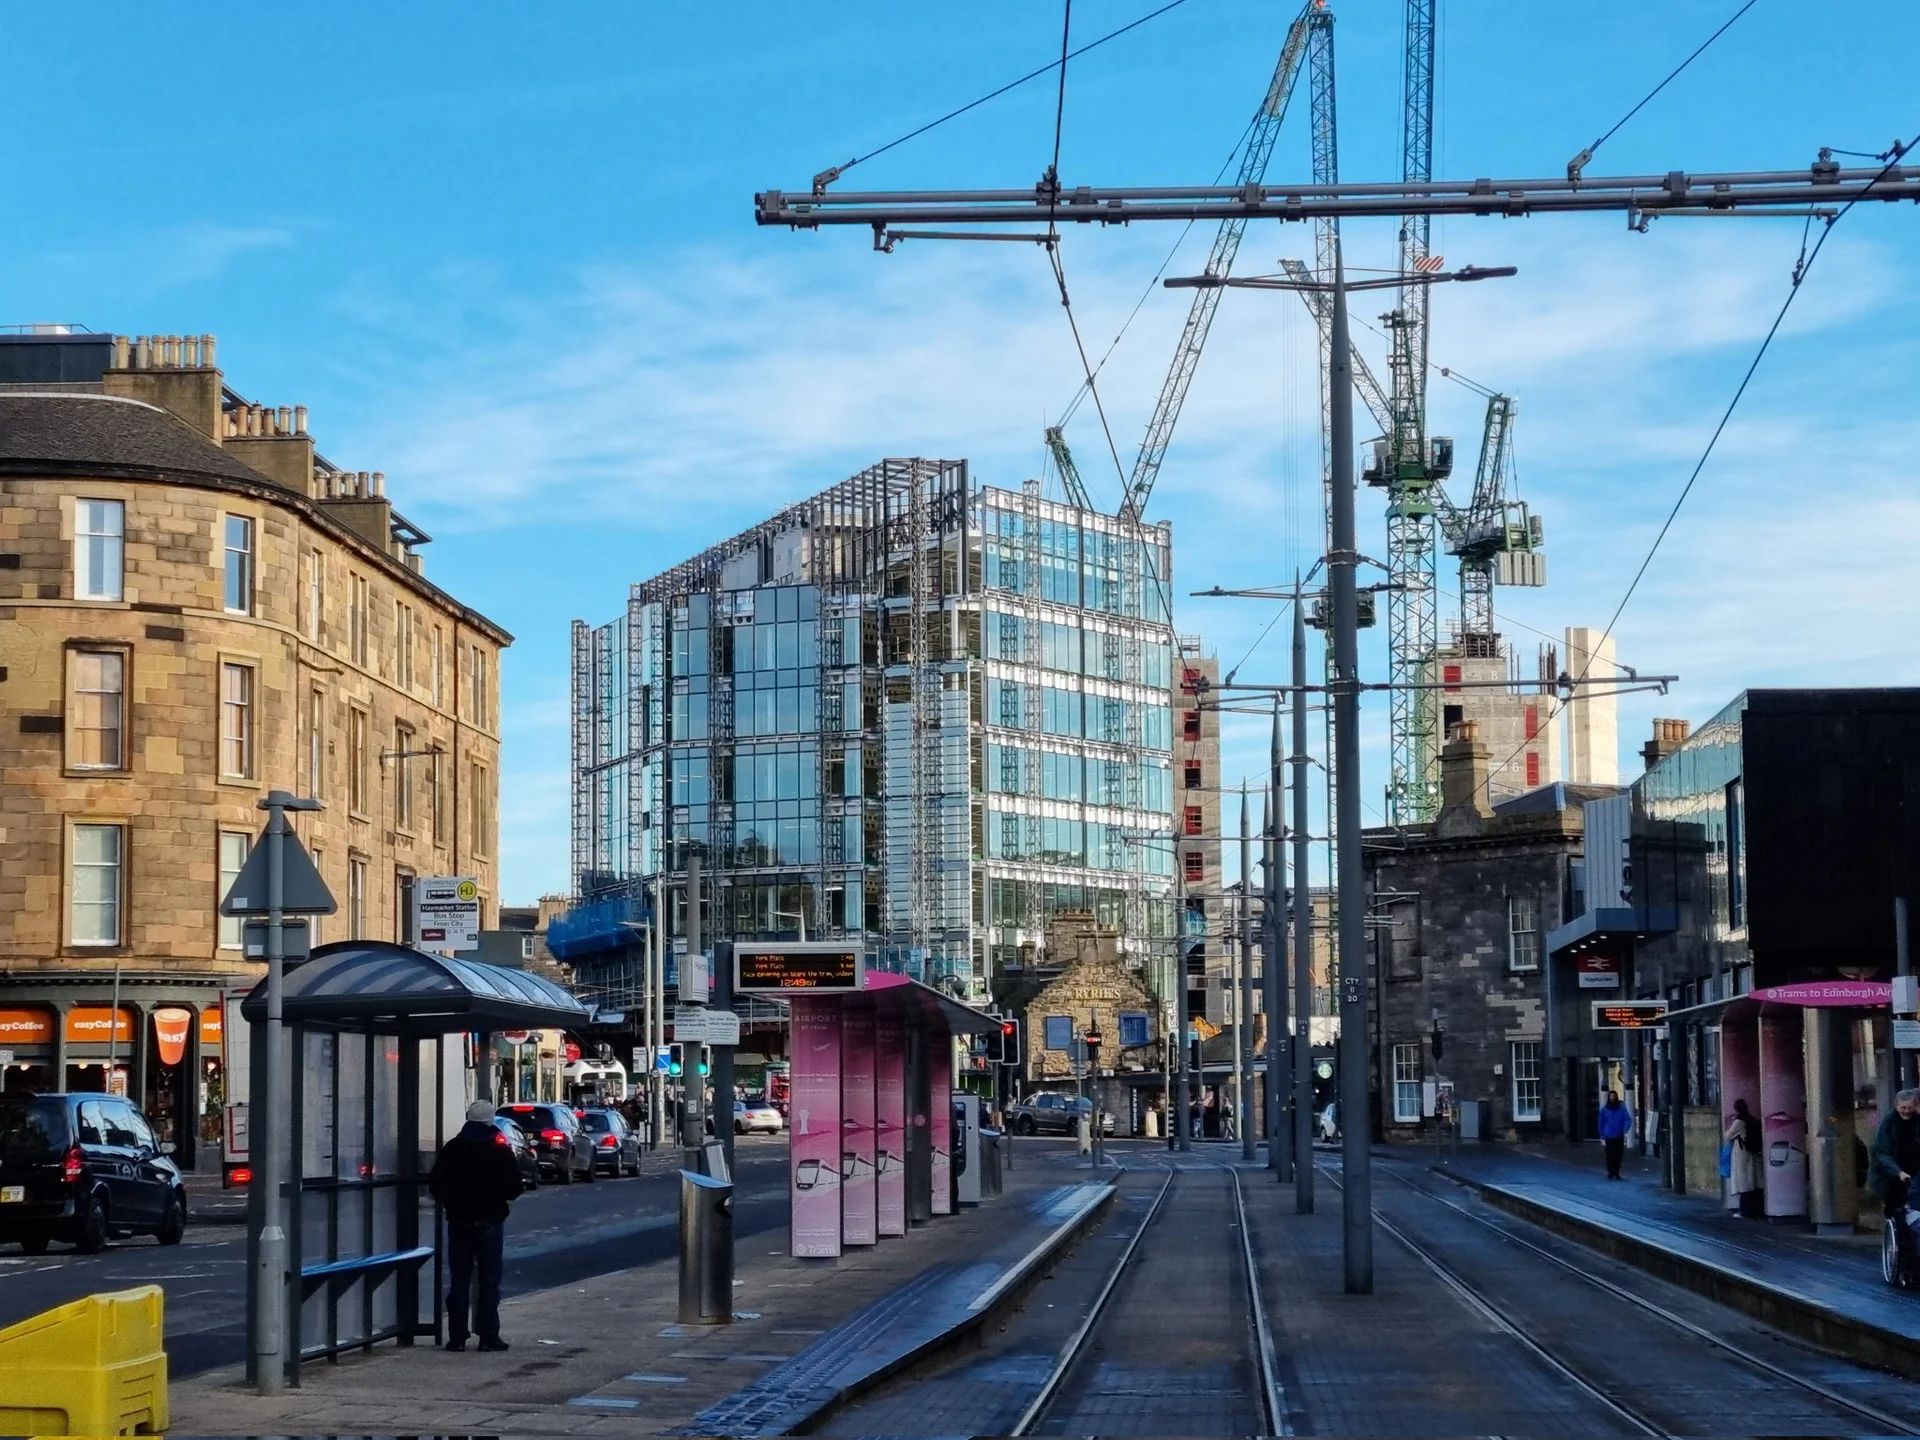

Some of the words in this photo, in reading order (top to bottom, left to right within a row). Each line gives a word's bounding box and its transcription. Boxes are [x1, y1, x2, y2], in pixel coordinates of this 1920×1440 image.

[460, 886, 474, 896] HJ
[1345, 977, 1360, 985] CTY
[1777, 988, 1807, 998] Trams
[1810, 989, 1820, 998] to
[1823, 987, 1874, 999] Edinburgh
[1877, 987, 1891, 997] Air
[794, 1014, 837, 1023] AIRPORT
[157, 1031, 186, 1043] easy
[115, 1162, 142, 1179] TAXI
